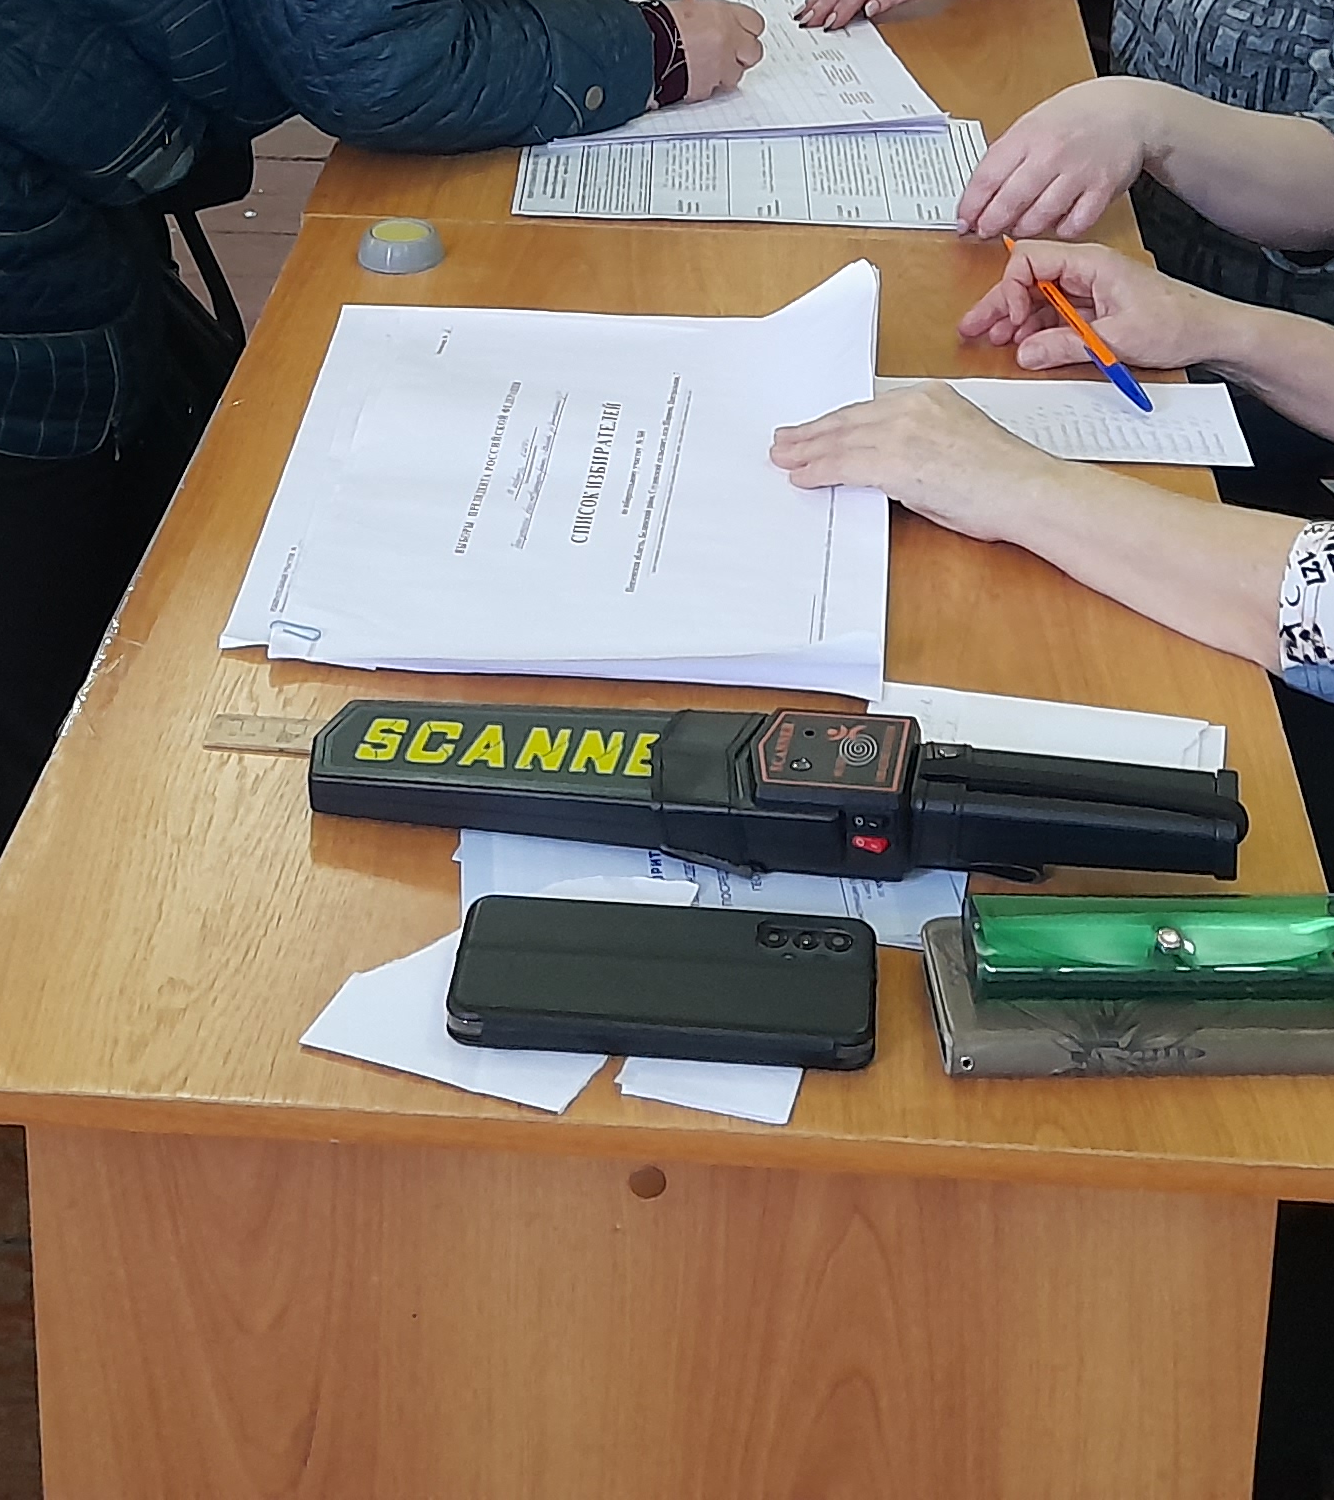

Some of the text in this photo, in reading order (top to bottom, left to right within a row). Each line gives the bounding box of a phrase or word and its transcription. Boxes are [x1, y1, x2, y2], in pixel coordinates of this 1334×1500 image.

[484, 414, 508, 471] РОССИЙСКОЙ
[571, 402, 622, 543] СПИСОК ИЗБИРАТЕЛЕЙ
[355, 718, 660, 777] SCANNE
[648, 851, 664, 879] РИТ
